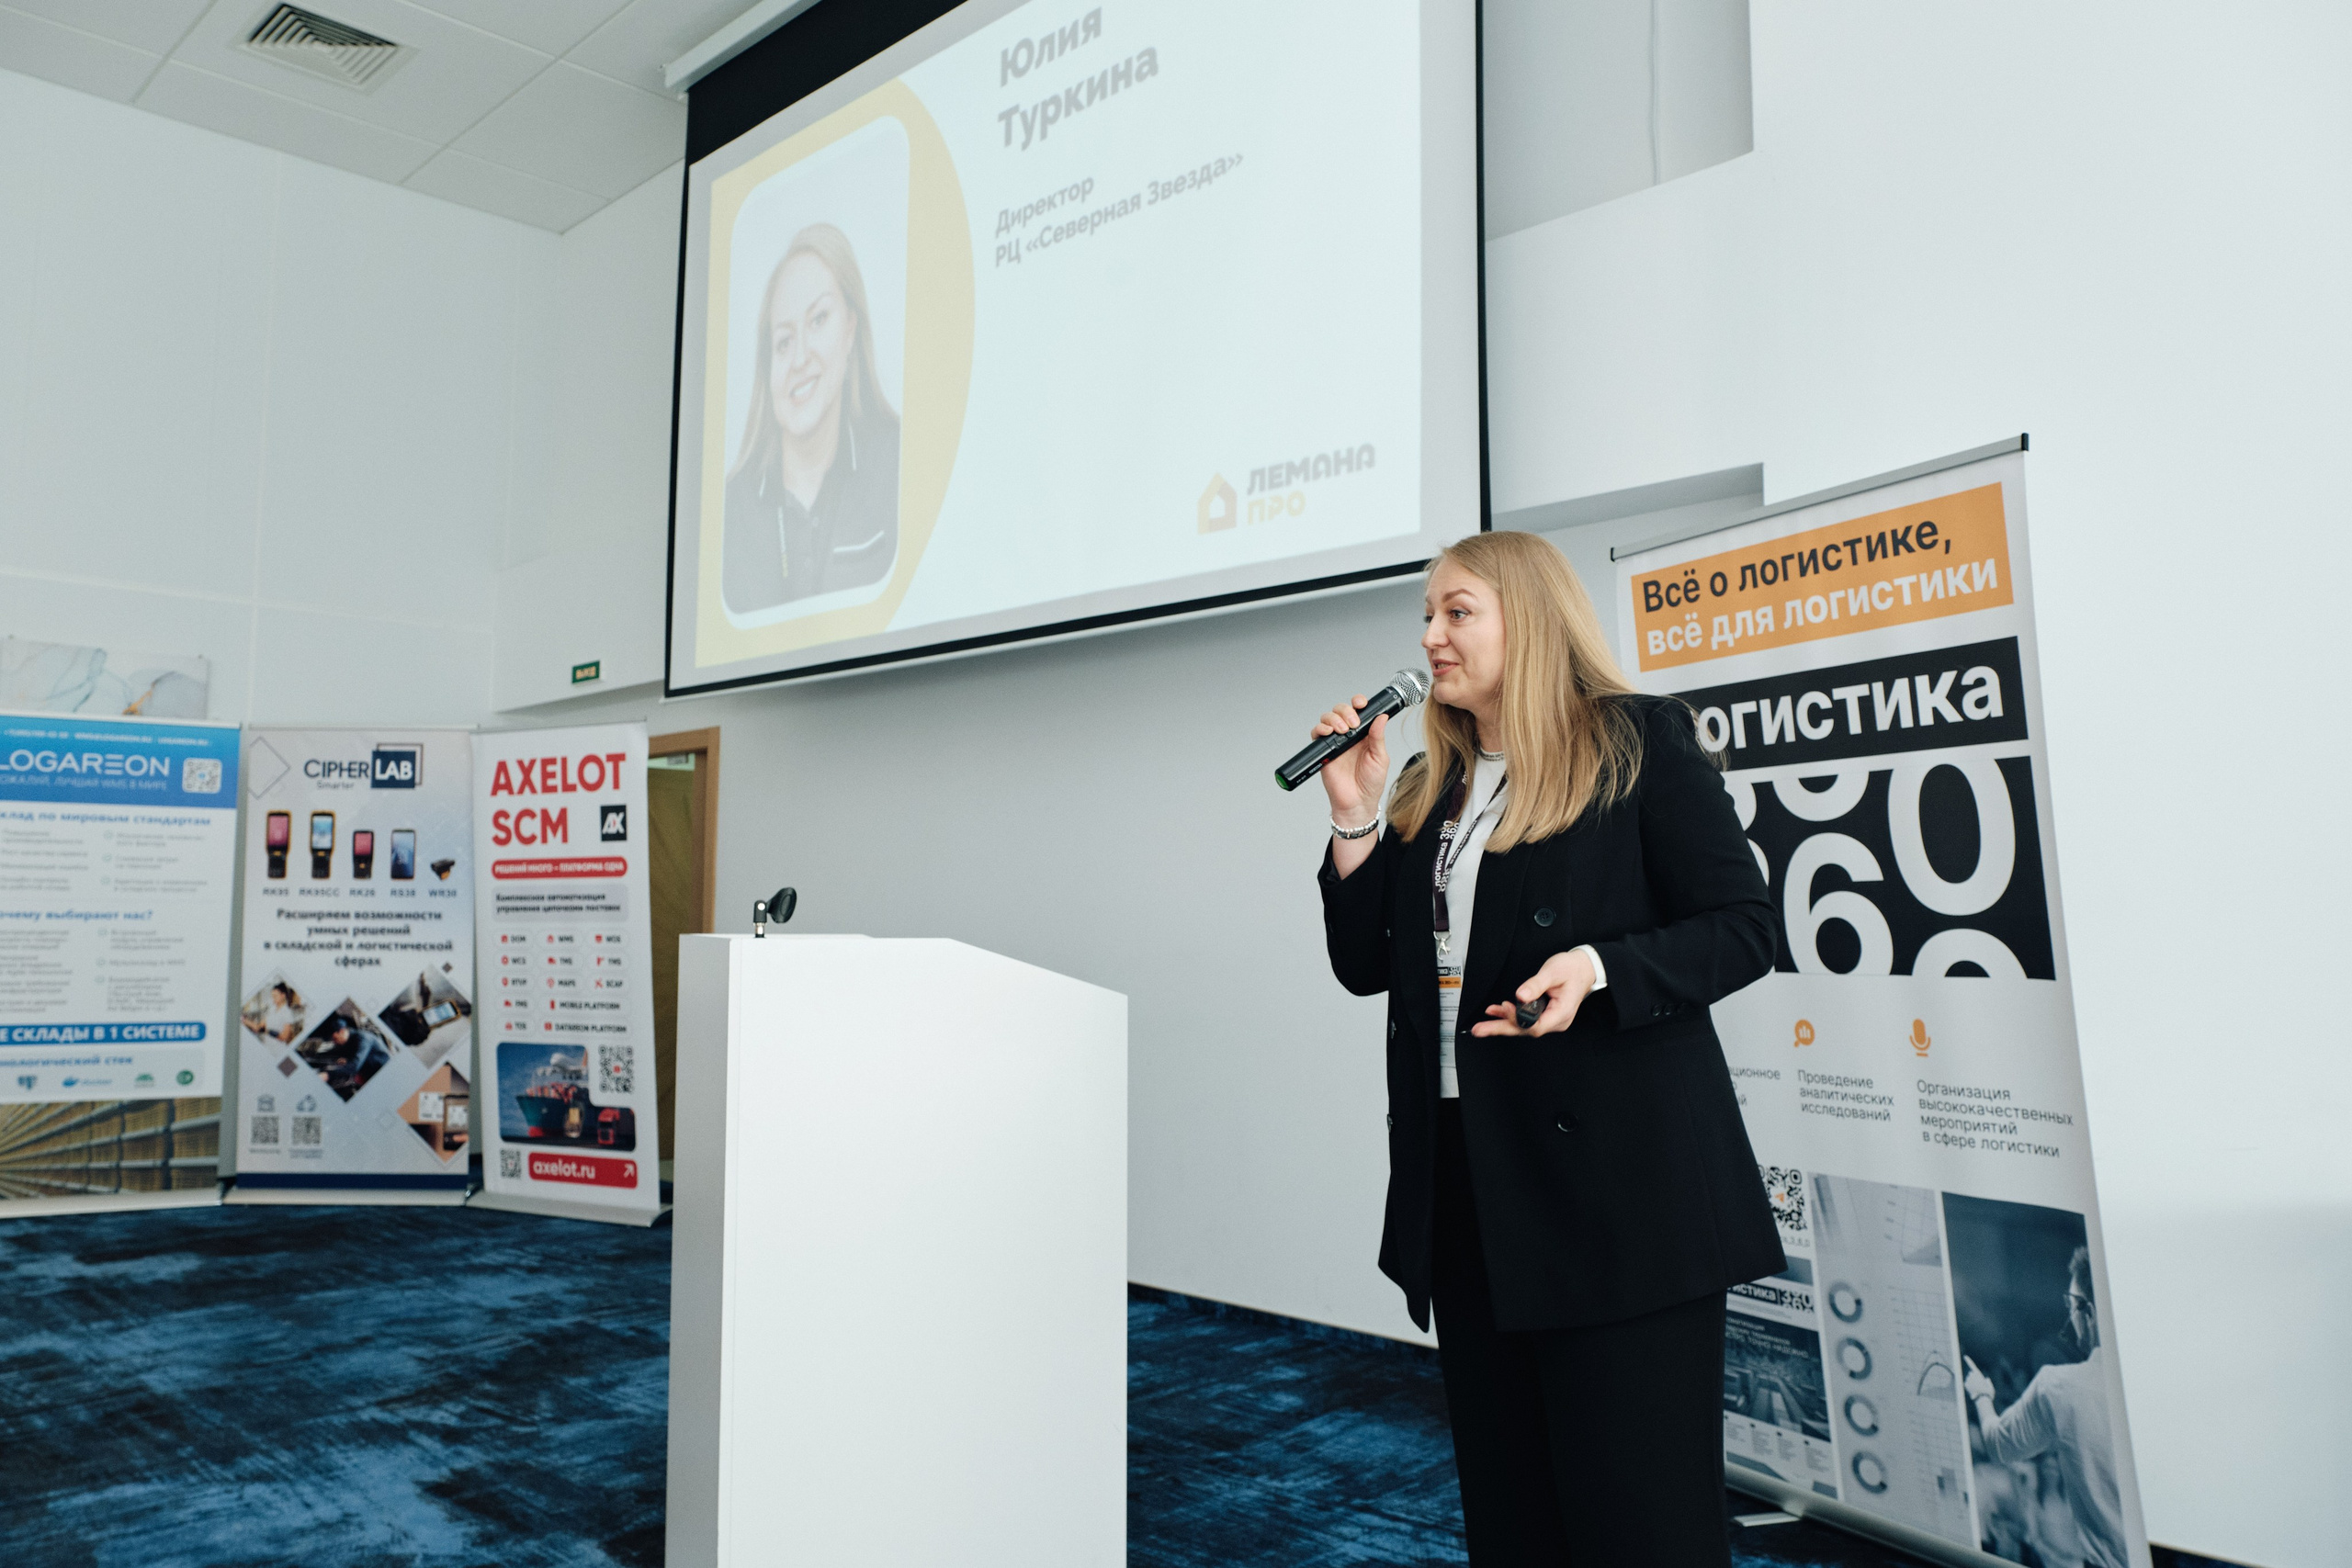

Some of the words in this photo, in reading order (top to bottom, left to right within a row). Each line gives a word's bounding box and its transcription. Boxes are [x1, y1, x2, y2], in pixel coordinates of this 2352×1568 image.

[1000, 6, 1102, 88] Юлия
[998, 46, 1159, 152] Туркина
[995, 176, 1094, 238] Директор
[995, 237, 1021, 267] РЦ
[1025, 193, 1141, 253] «Северная
[1147, 152, 1244, 206] Звезда»
[1247, 443, 1375, 495] ЛЕМАНА
[1248, 491, 1306, 525] ПРО
[1643, 570, 1701, 613] Всё
[1710, 571, 1728, 597] о
[1738, 521, 1951, 592] логистике,
[1647, 612, 1702, 656] всё
[1711, 607, 1774, 650] для
[1784, 558, 1998, 629] логистики
[1696, 665, 2004, 753] огистика
[490, 752, 627, 796] AXELOT
[0, 812, 34, 822] клад
[492, 807, 569, 847] SCM
[277, 908, 350, 920] Расширяем
[354, 910, 442, 920] возможности
[307, 926, 348, 937] умных
[353, 924, 411, 937] решений
[276, 941, 342, 952] складской
[356, 941, 453, 952] логистической
[334, 956, 381, 968] сферах
[12, 1026, 89, 1043] СКЛАДЫ
[94, 1027, 105, 1041] В
[109, 1027, 118, 1040] 1
[122, 1024, 199, 1040] СИСТЕМЕ
[1797, 1069, 1873, 1089] Проведение
[1917, 1079, 2010, 1101] Организация
[1800, 1088, 1894, 1107] аналитических
[1801, 1103, 1891, 1122] исследований
[1918, 1098, 2074, 1126] высококачественных
[1920, 1114, 2018, 1136] мероприятий
[1923, 1131, 1930, 1142] в
[1934, 1132, 1976, 1149] сфере
[1981, 1138, 2060, 1158] логистики
[533, 1158, 595, 1179] axelot.ru
